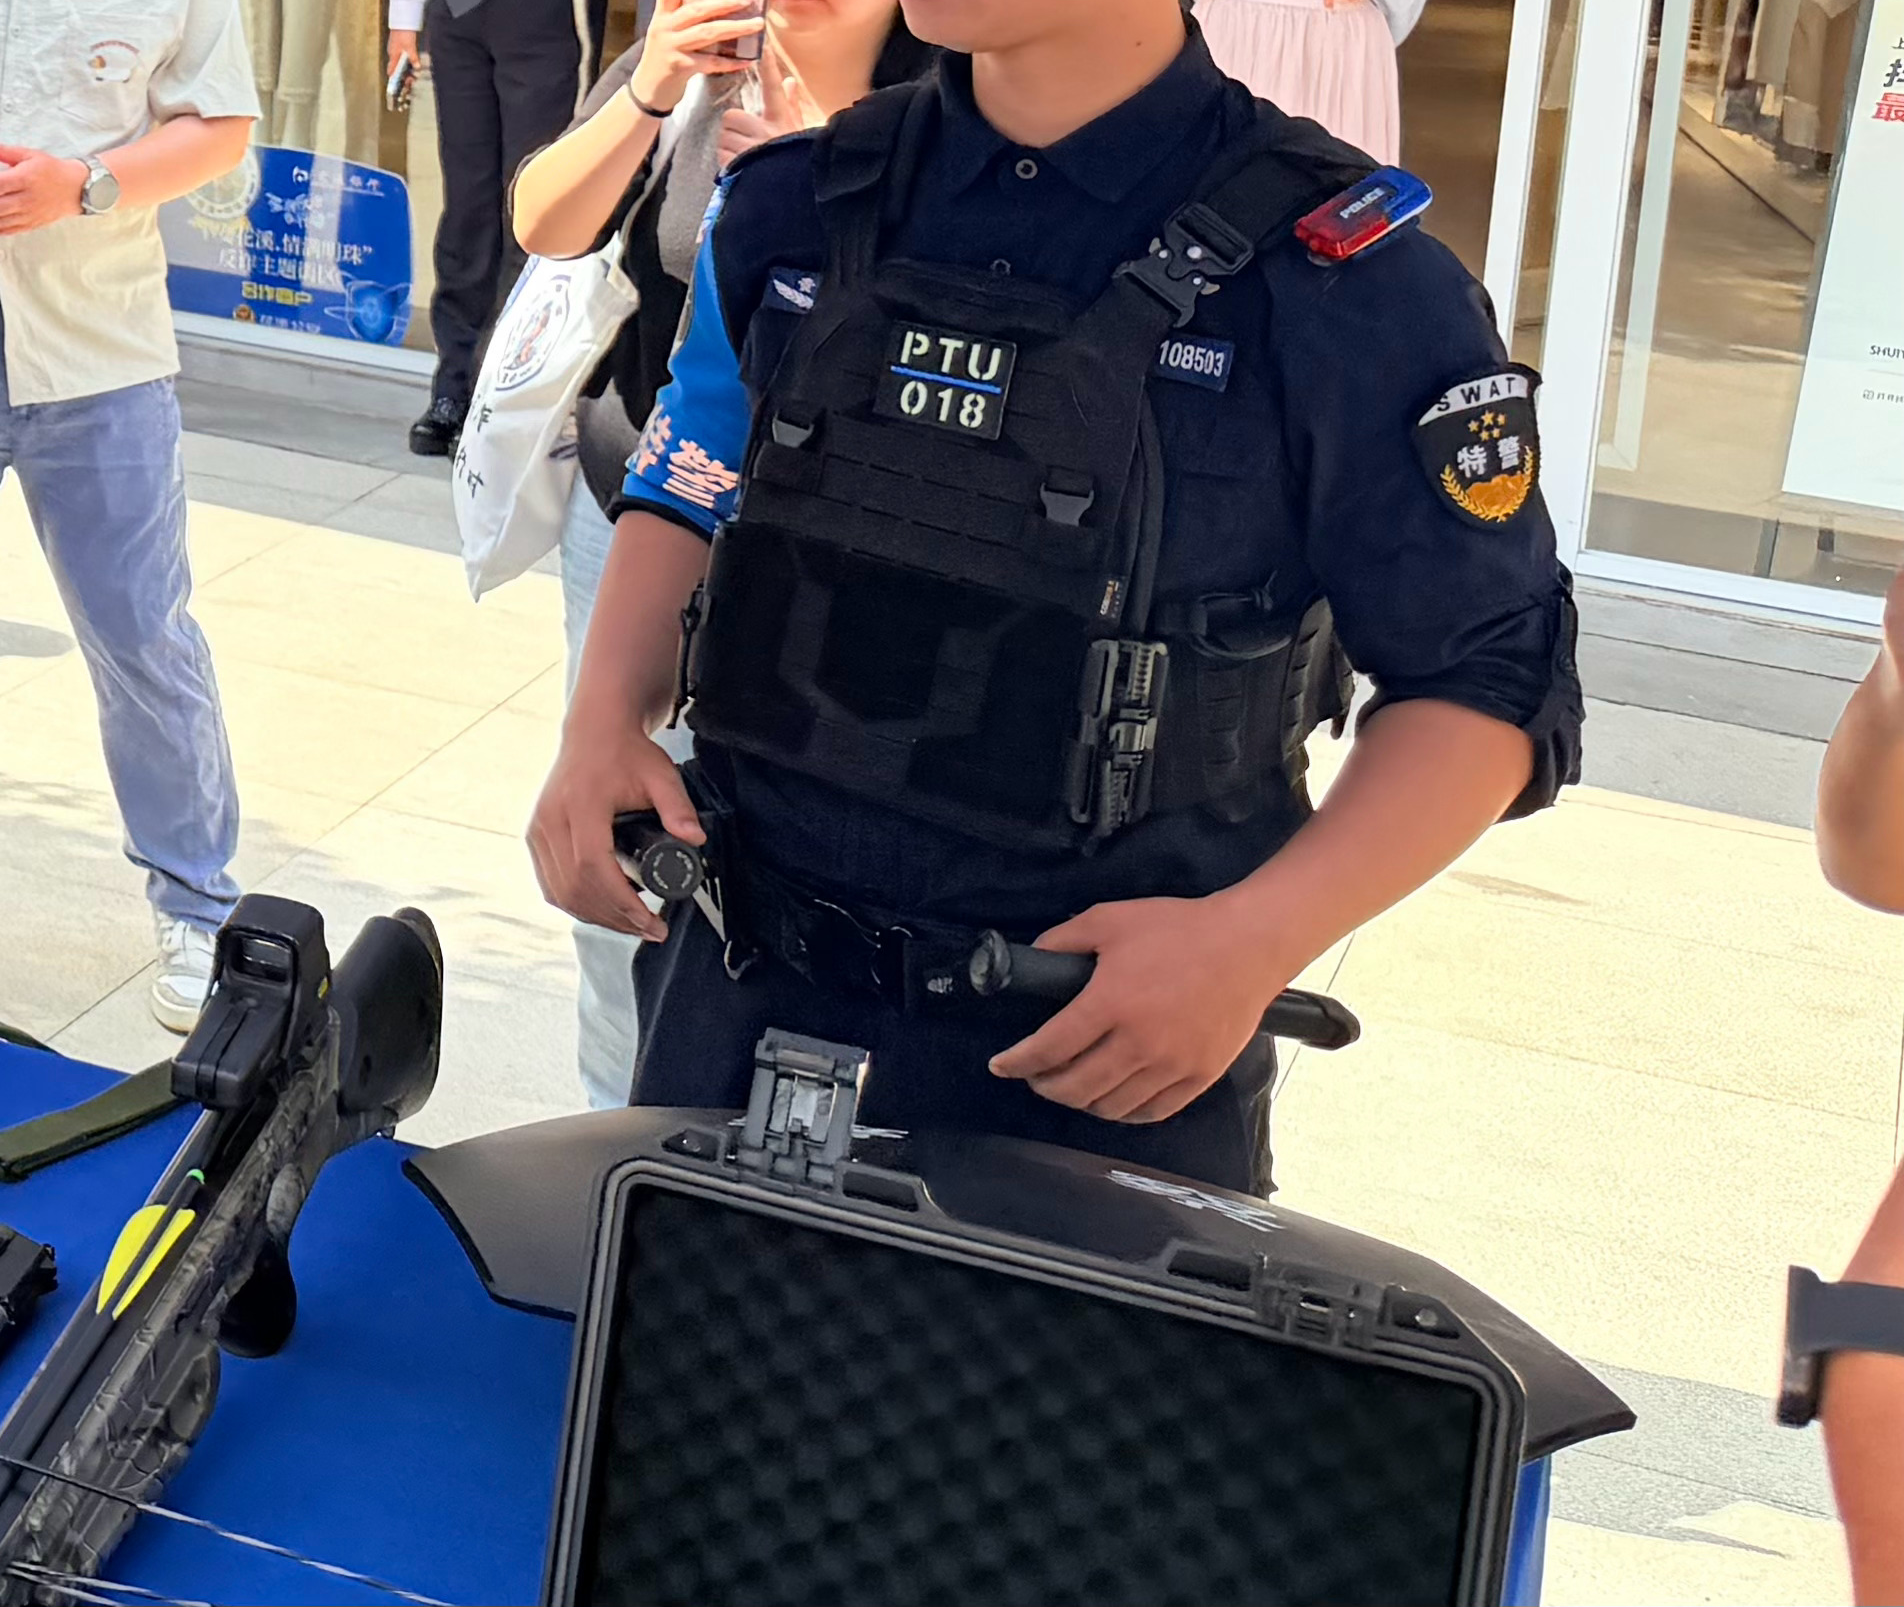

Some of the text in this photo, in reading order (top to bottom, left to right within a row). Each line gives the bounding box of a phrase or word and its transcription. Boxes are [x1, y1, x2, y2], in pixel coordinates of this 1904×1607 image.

[1339, 187, 1385, 219] POLICE
[900, 330, 1003, 381] PTU
[1159, 339, 1227, 378] 108503
[899, 380, 987, 429] 018
[1437, 377, 1516, 412] SWAT
[1456, 435, 1520, 478] 特警
